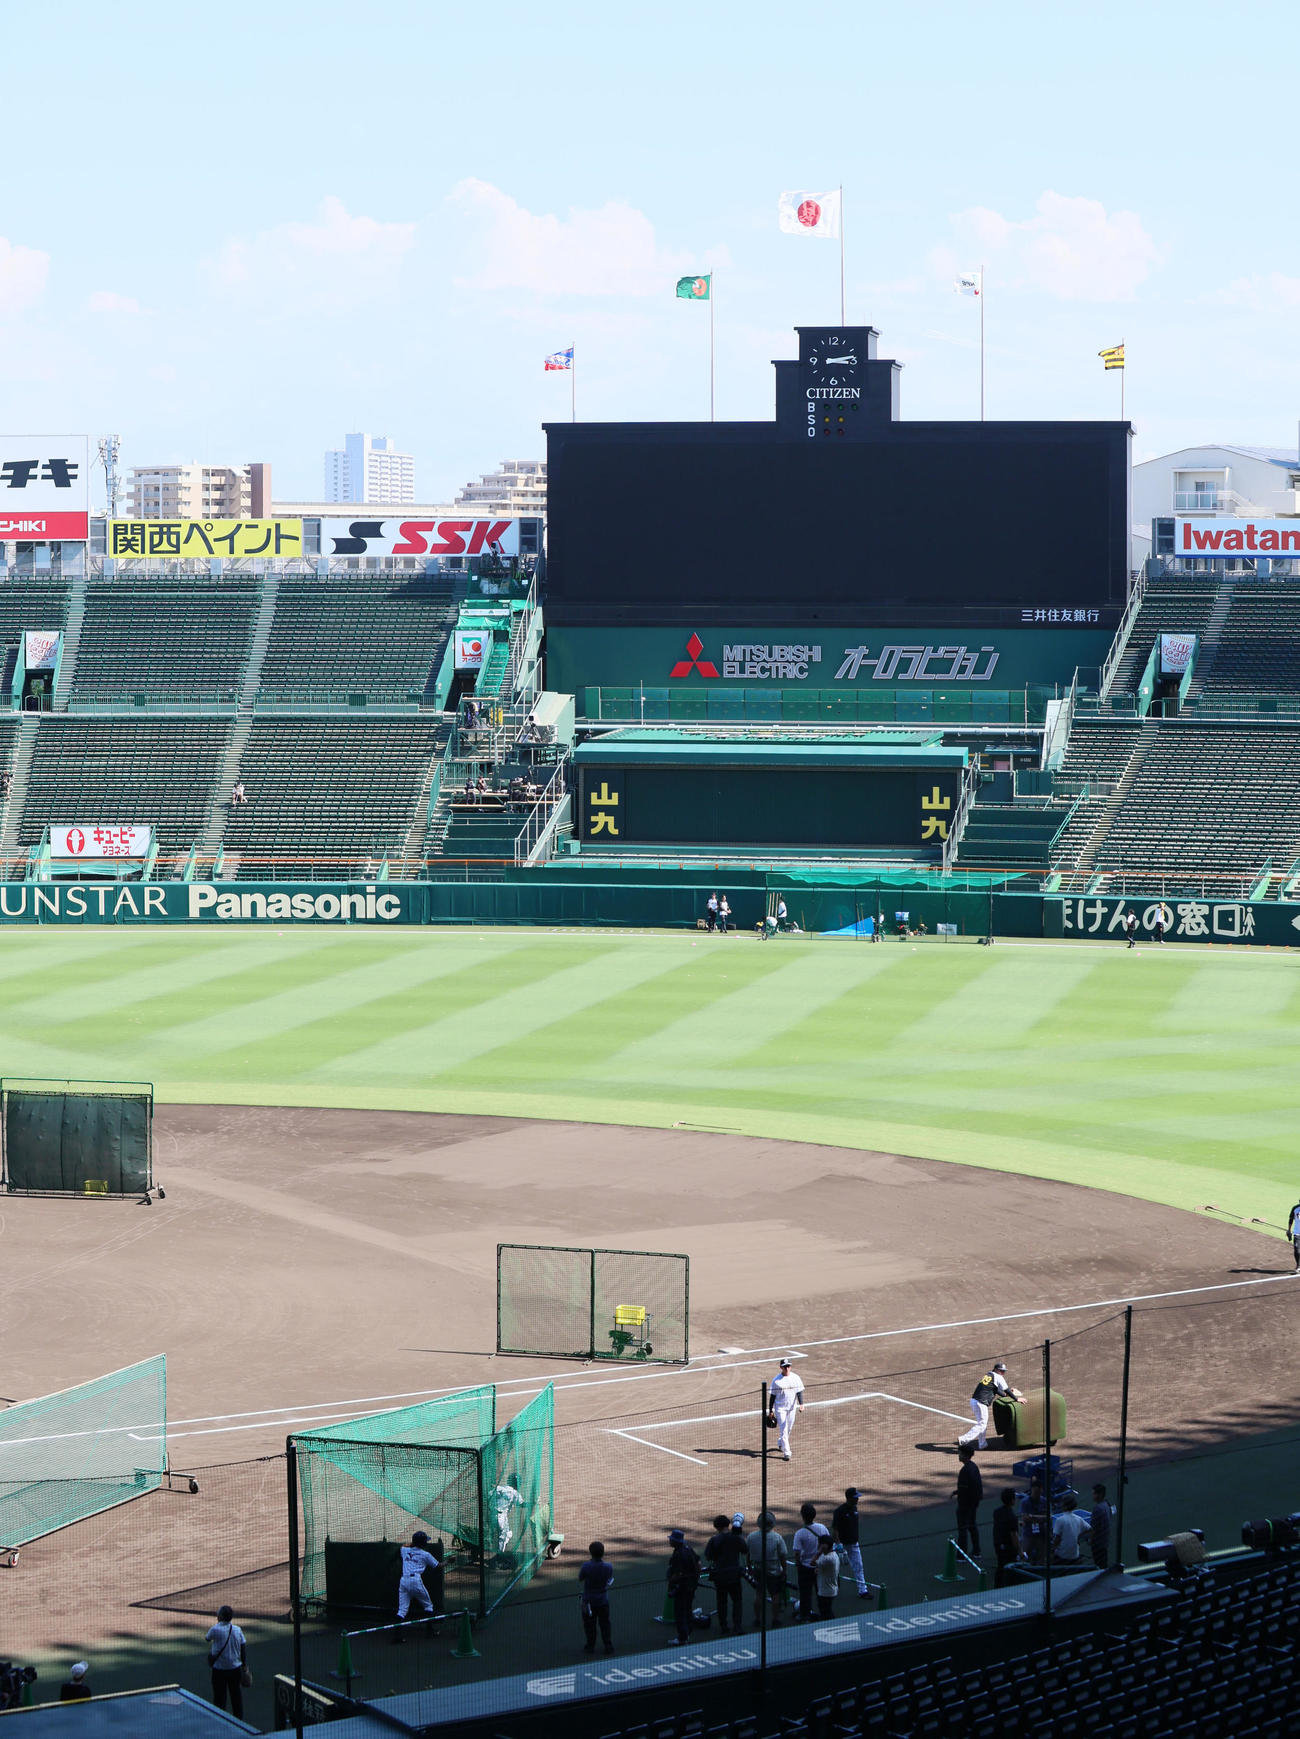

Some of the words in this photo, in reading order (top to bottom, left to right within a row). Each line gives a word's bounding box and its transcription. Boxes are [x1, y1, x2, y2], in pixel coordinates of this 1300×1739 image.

[828, 337, 839, 345] 12
[809, 357, 818, 365] 9
[849, 355, 858, 365] 3
[829, 377, 838, 385] 6
[806, 388, 860, 399] CITIZEN
[807, 402, 816, 413] B
[807, 415, 816, 425] S
[113, 523, 299, 555] 関西ペイント
[392, 521, 512, 554] SSK
[1183, 523, 1300, 551] Iwatan
[1021, 609, 1100, 622] 三井住友銀行
[723, 645, 821, 662] MITSUBISHI
[834, 645, 1000, 680] オーロラビジョン
[723, 662, 809, 679] ELECTRIC
[590, 782, 619, 835] 山九
[921, 786, 950, 840] 山九
[93, 826, 136, 844] キューピー
[0, 886, 168, 917] UNSTAR
[188, 885, 401, 920] Panasonic
[866, 1599, 1026, 1633] idemitsu
[584, 1649, 758, 1686] idemitsu
